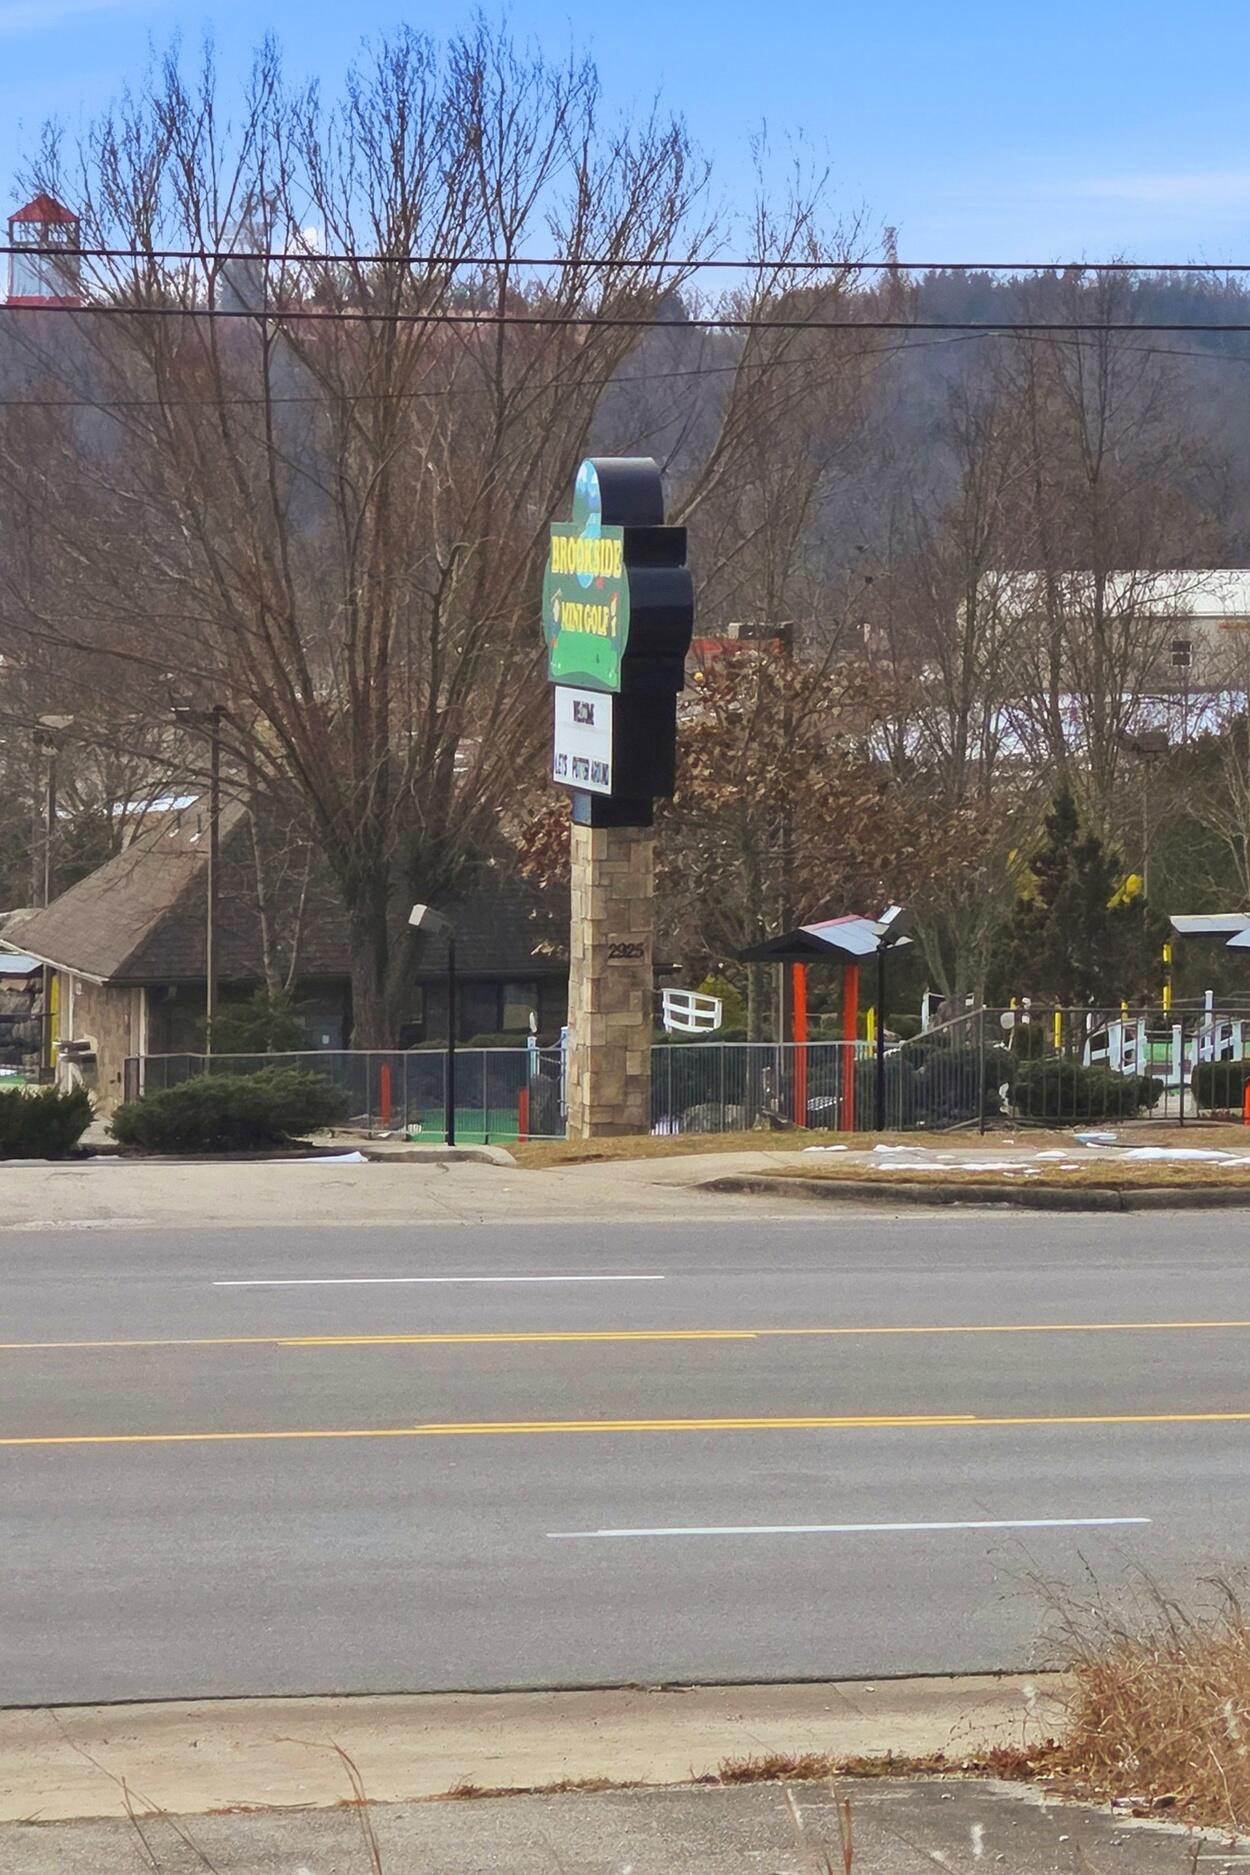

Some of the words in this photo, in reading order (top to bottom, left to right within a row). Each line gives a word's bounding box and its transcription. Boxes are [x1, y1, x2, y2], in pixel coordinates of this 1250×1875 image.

[551, 536, 623, 578] BROOKSIDE
[561, 602, 583, 633] MINI
[584, 604, 610, 636] GOLF
[608, 943, 644, 959] 2925
